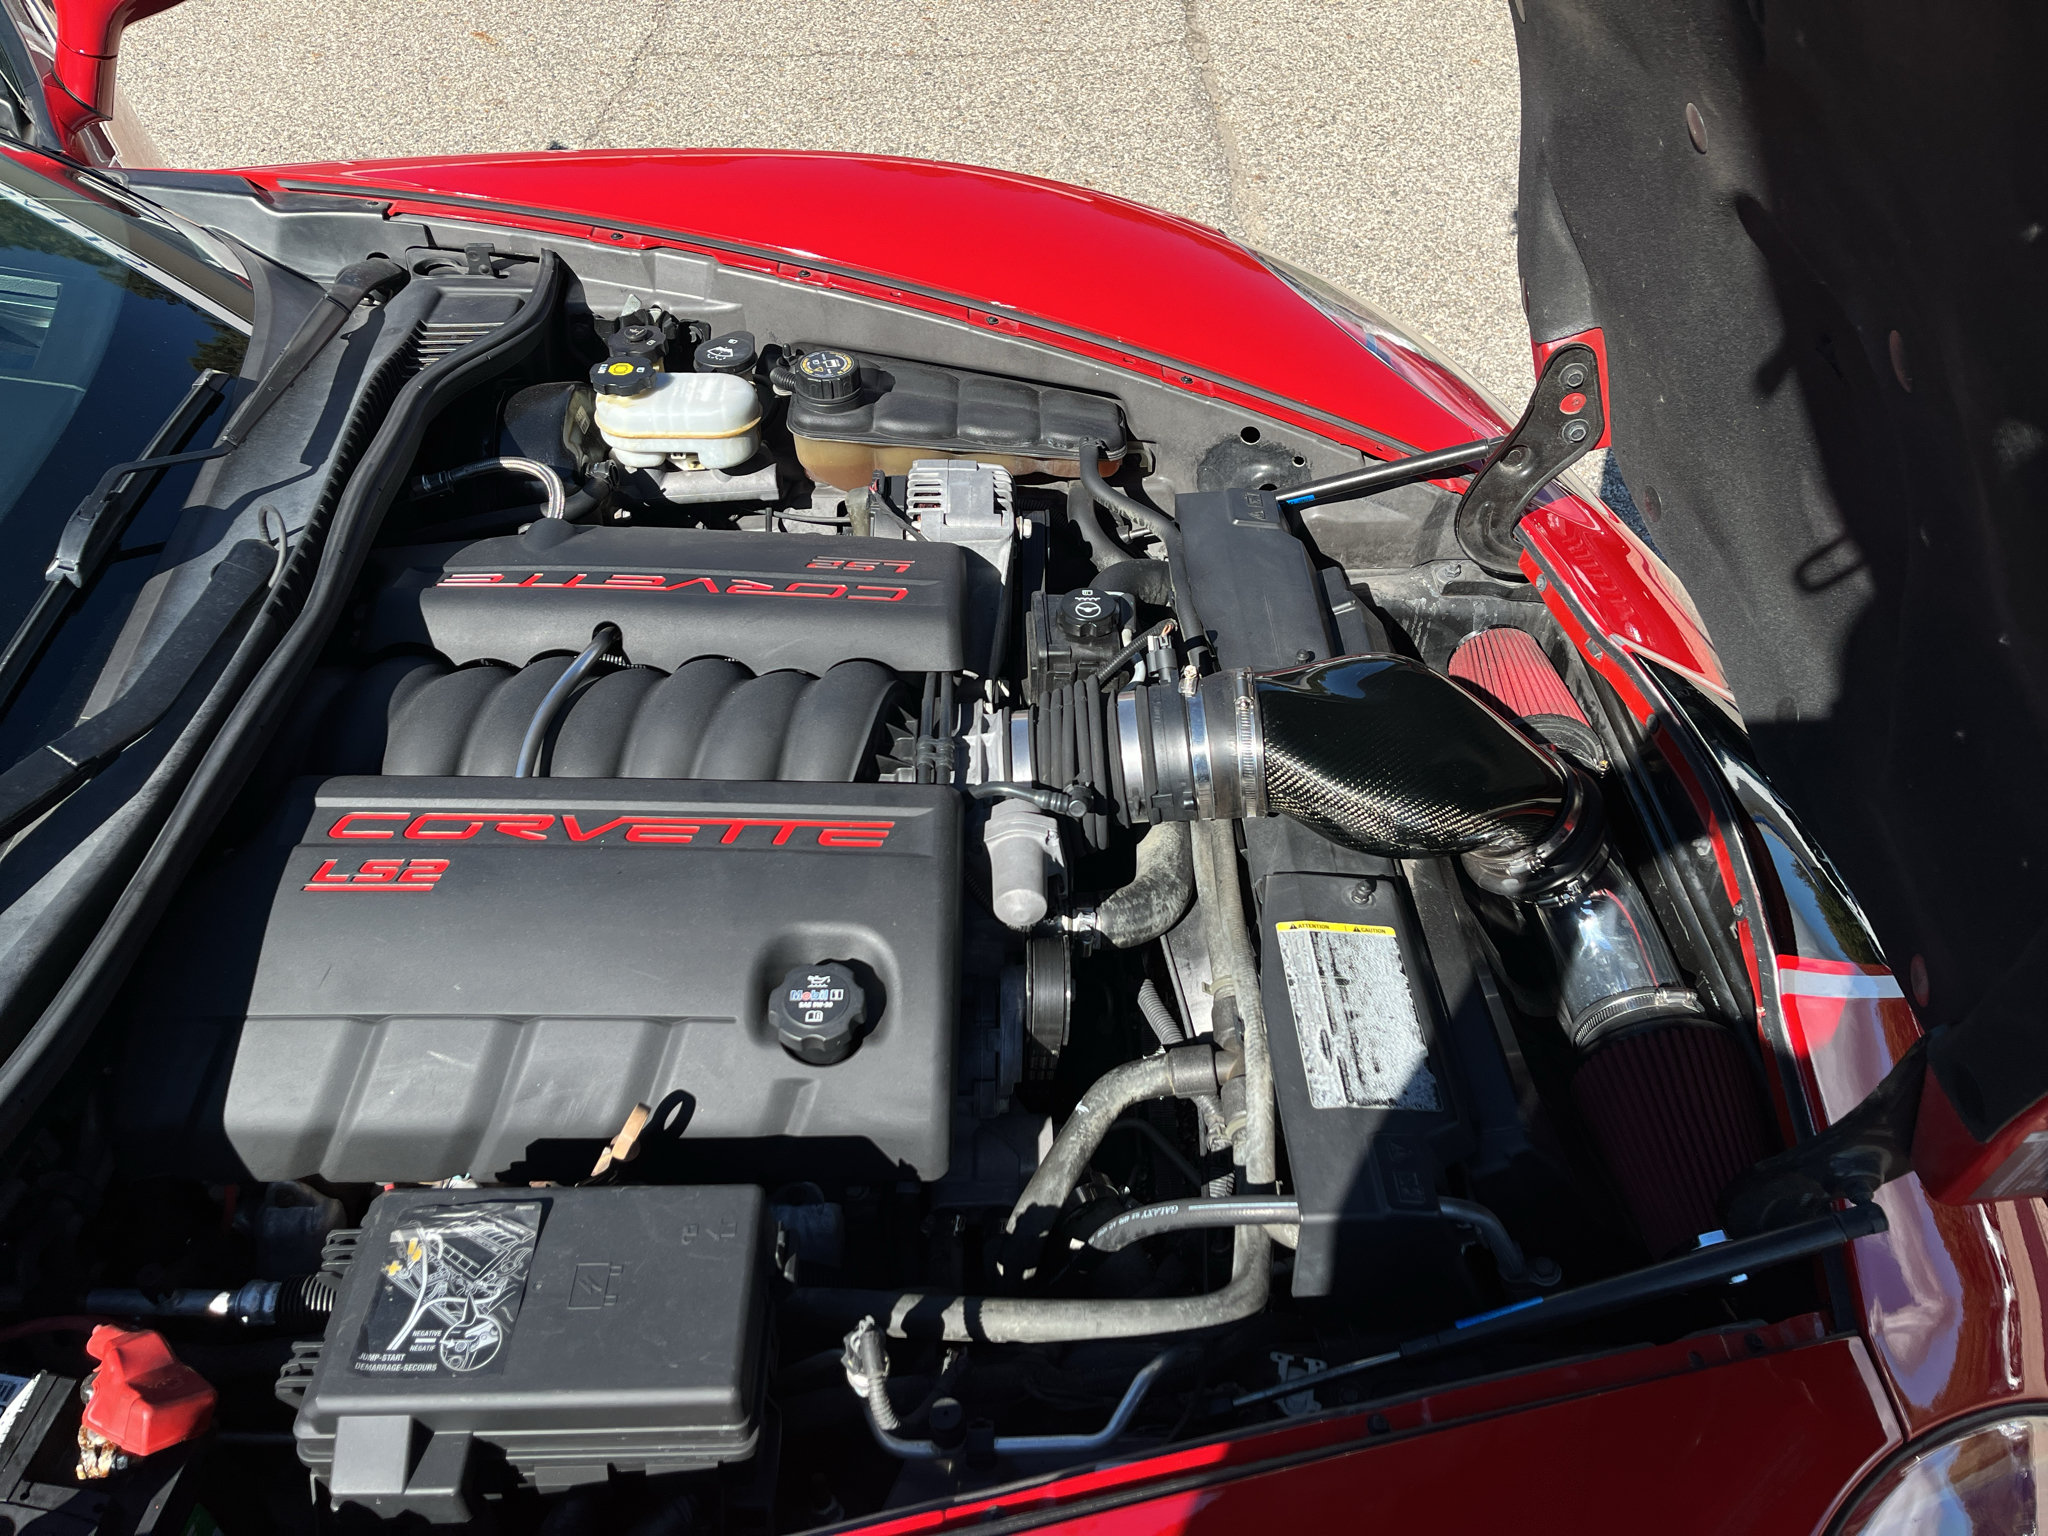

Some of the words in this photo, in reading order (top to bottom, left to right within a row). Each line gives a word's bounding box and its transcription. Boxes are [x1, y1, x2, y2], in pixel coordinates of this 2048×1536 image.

[805, 556, 915, 574] LS2
[436, 573, 909, 602] CORVETTE
[328, 812, 896, 848] CORVETTE
[305, 857, 451, 888] LS2
[790, 990, 829, 1002] Mobil
[1141, 1205, 1179, 1219] GALAXY
[358, 1352, 406, 1361] JUMP-START
